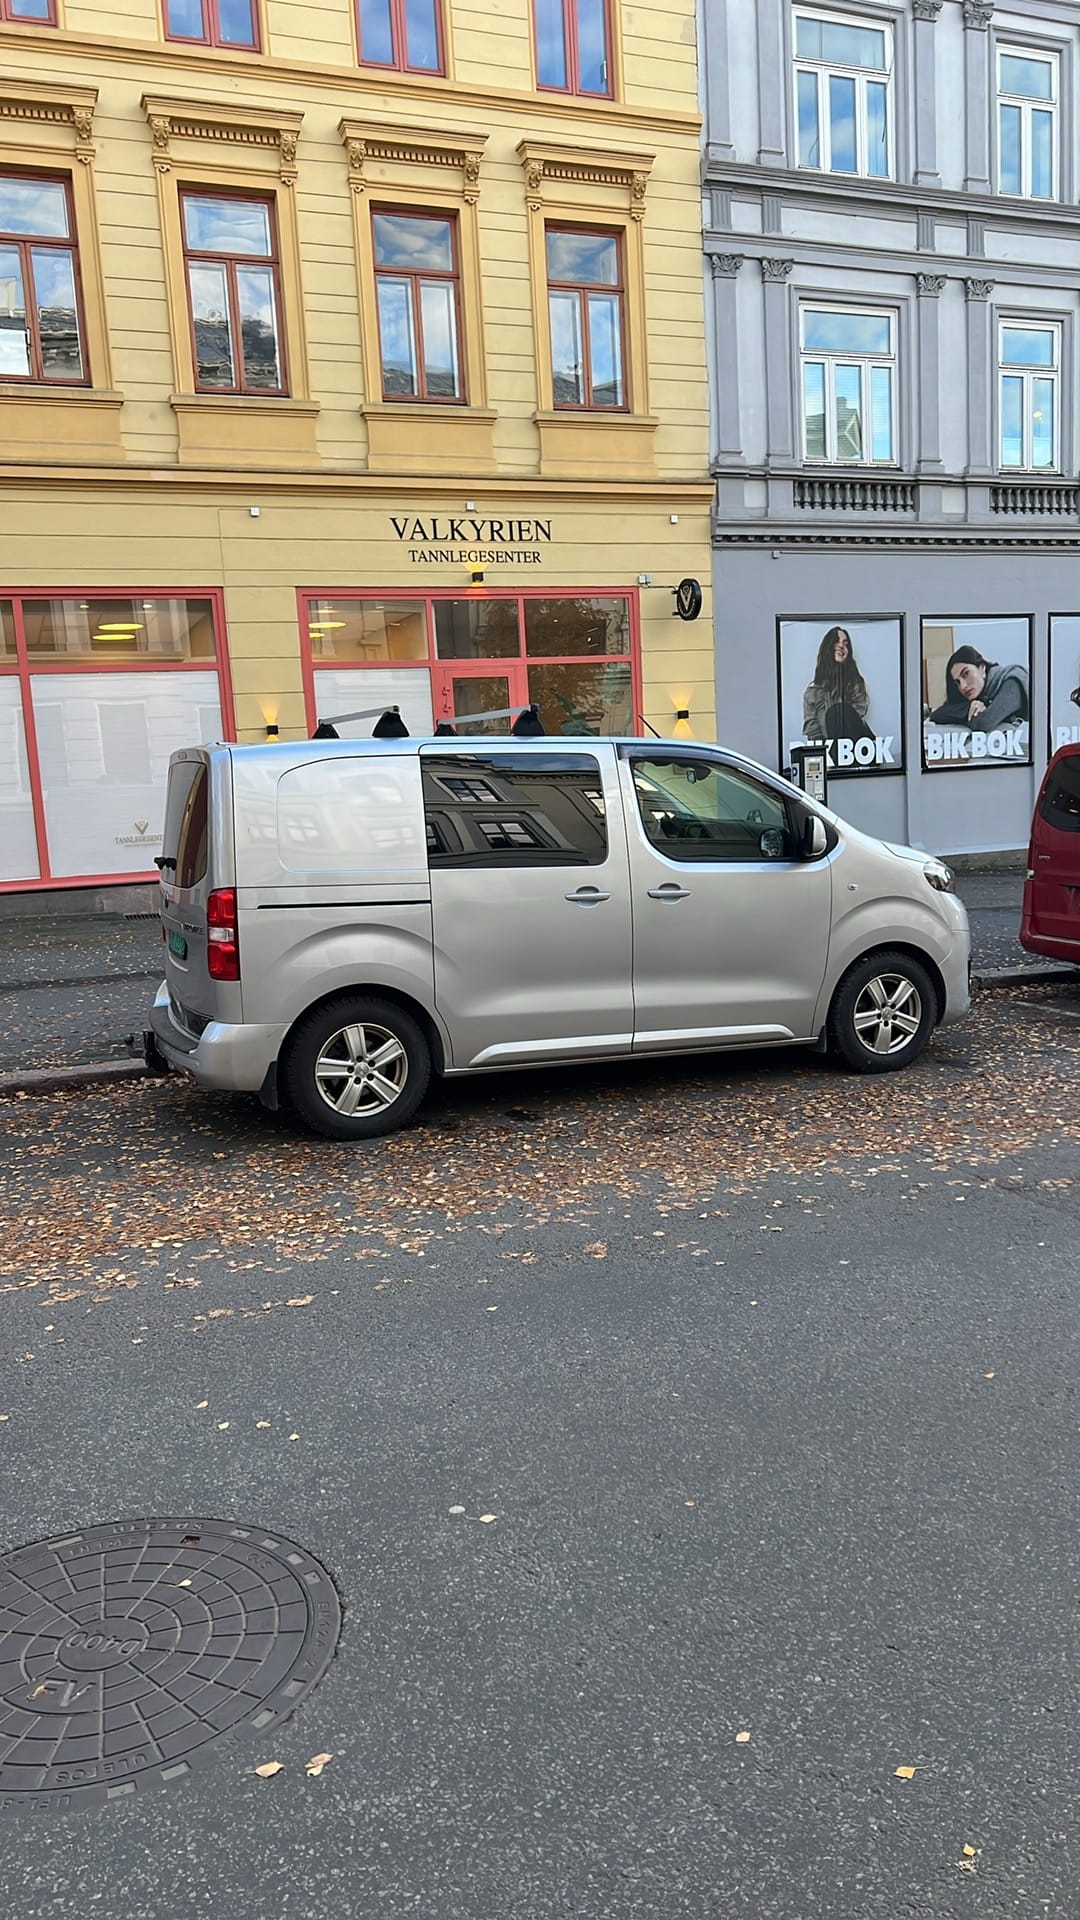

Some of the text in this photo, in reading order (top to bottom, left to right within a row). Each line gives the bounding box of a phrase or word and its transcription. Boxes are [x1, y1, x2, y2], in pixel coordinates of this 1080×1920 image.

[390, 517, 552, 542] VALKYRIEN
[409, 550, 542, 564] TANNLEGESENTER
[968, 729, 1024, 758] BOK
[1056, 726, 1080, 748] BI
[837, 736, 895, 766] BOK
[66, 1631, 142, 1656] D400
[55, 1753, 147, 1782] ULEFOS
